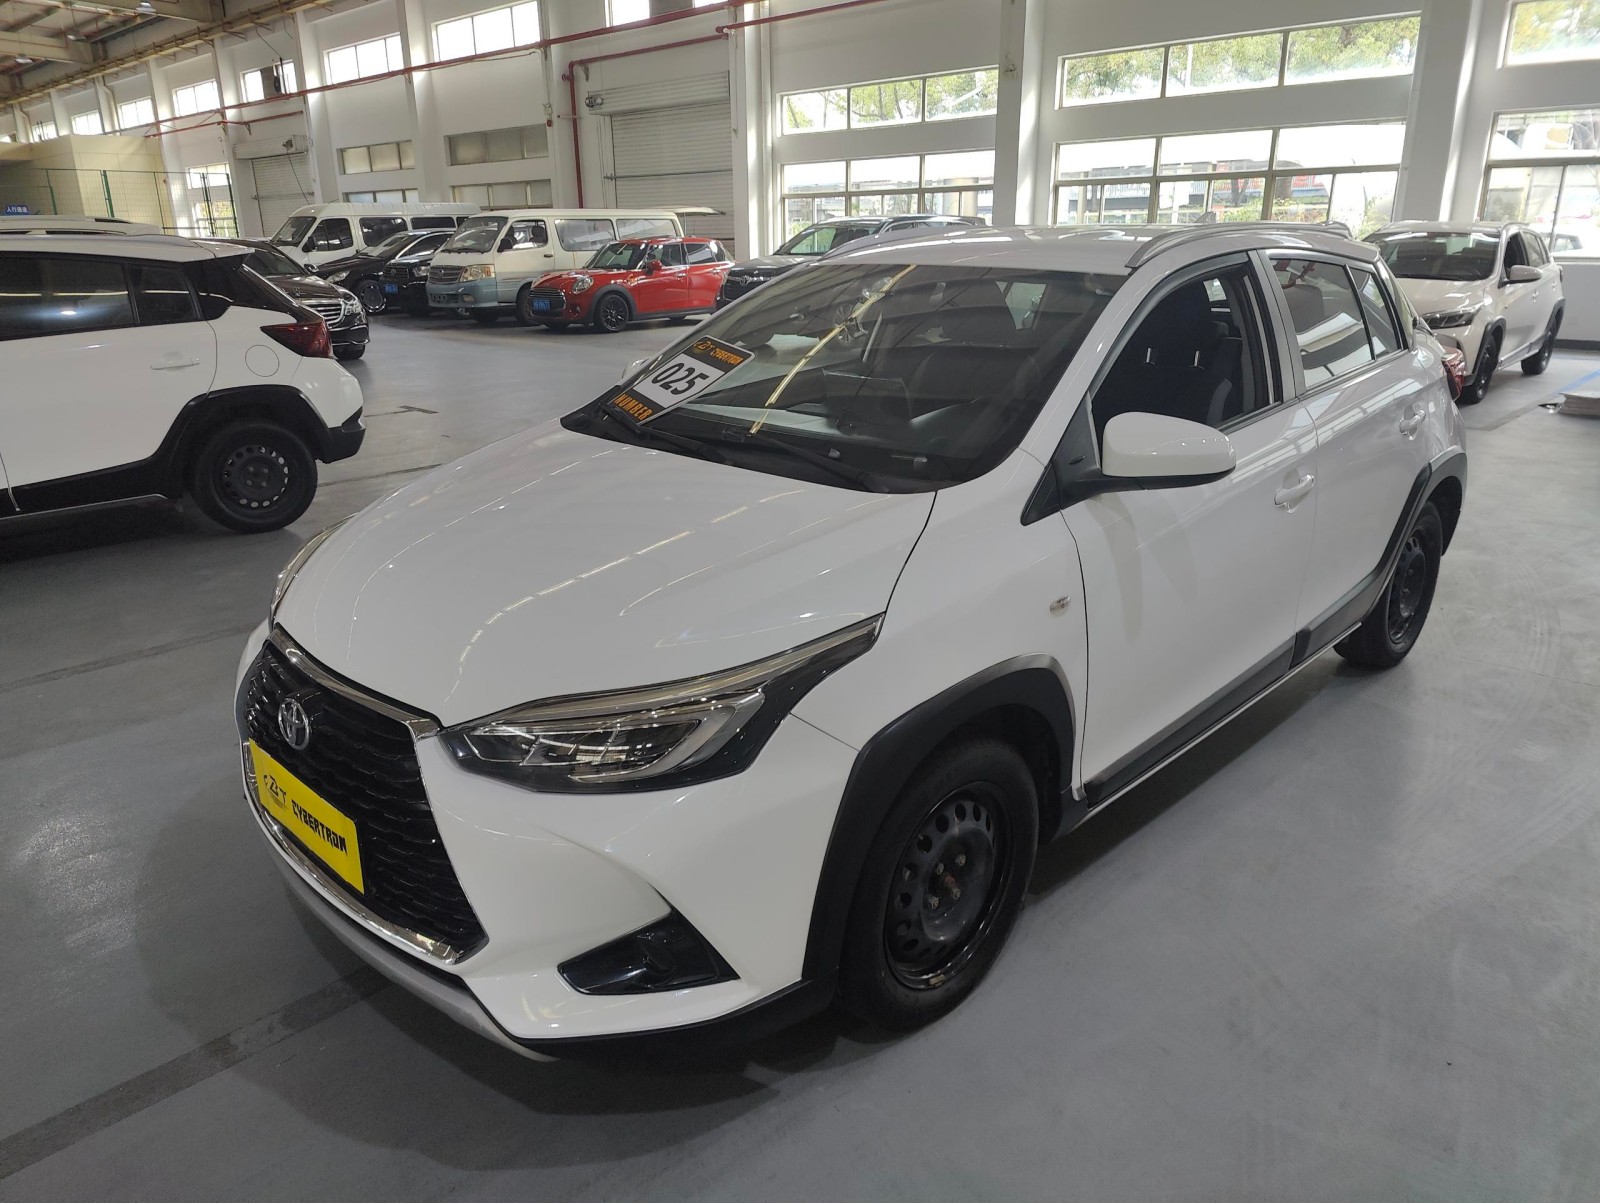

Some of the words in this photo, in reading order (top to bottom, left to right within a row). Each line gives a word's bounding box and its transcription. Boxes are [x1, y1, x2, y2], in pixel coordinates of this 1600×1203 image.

[651, 362, 710, 396] 025
[613, 393, 653, 421] NUMBER
[291, 799, 348, 855] CYBERTRON
